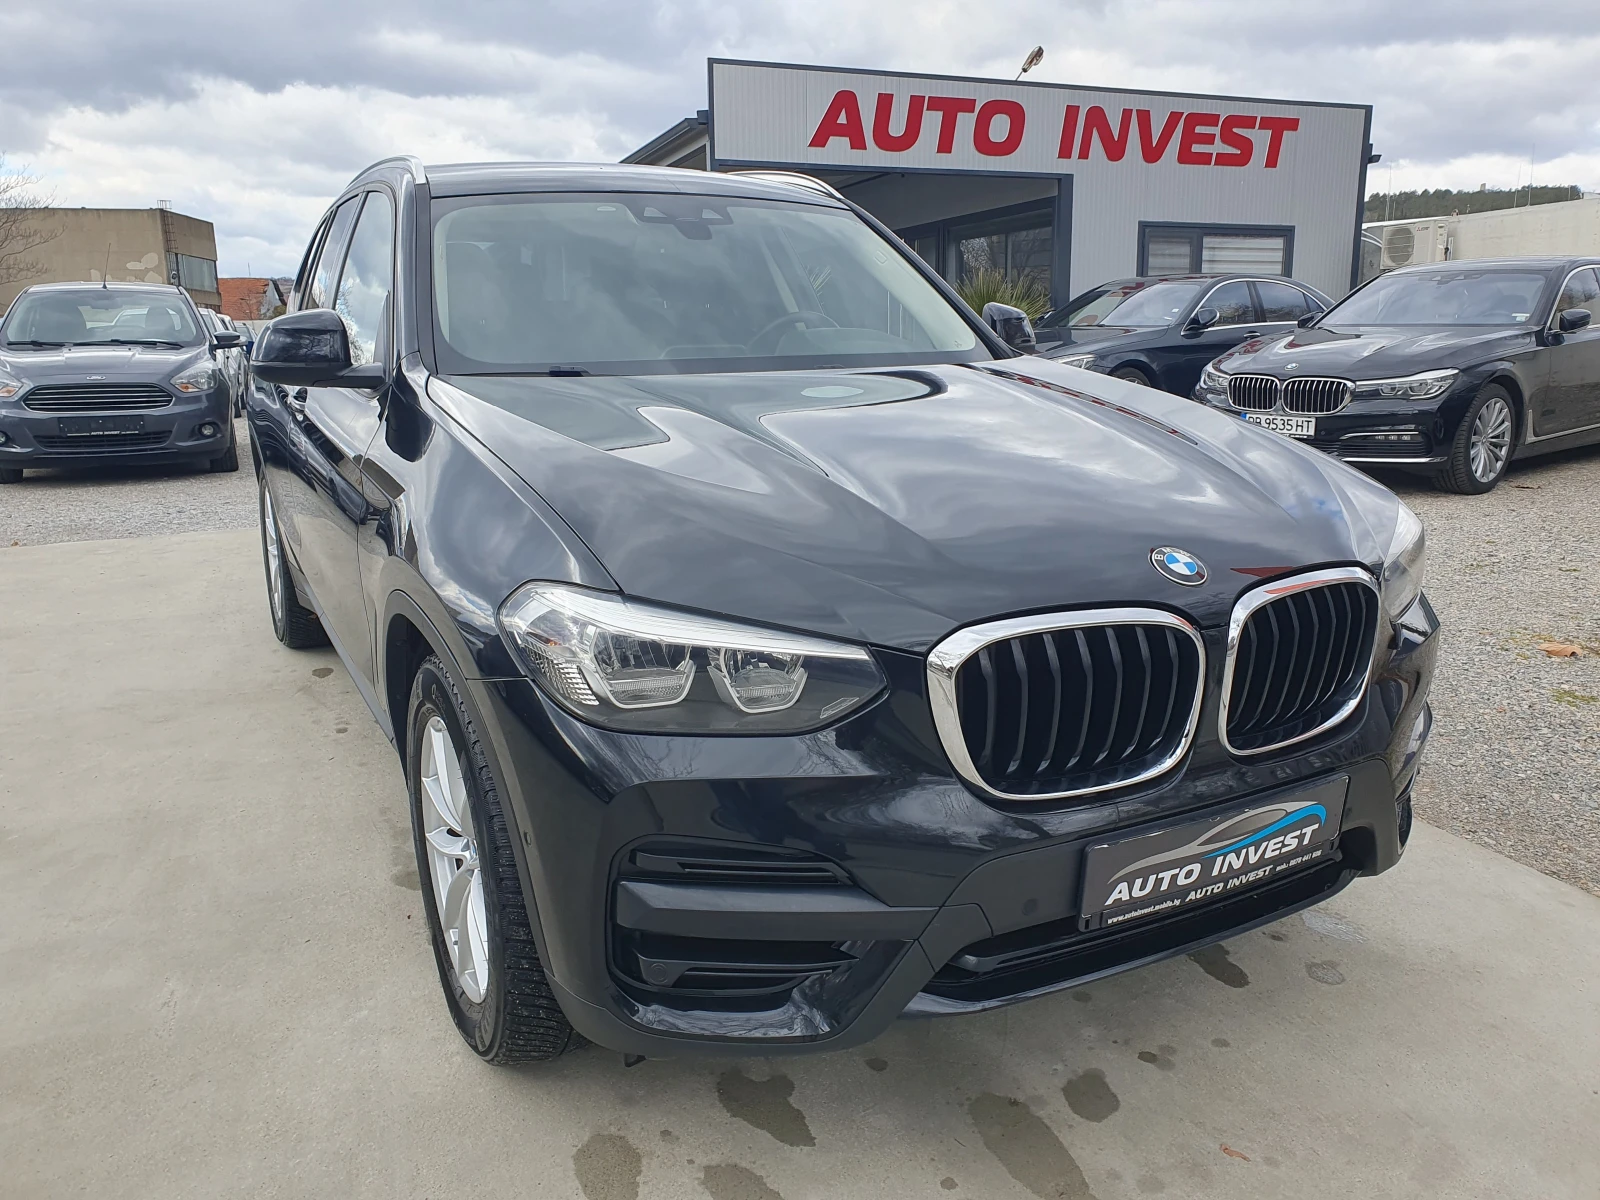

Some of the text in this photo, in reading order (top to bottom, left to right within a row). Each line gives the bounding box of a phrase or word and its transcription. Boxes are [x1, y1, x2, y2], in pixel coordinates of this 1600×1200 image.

[808, 90, 1301, 169] AUTO INVEST
[1264, 417, 1294, 432] 9535
[1295, 419, 1313, 433] HT
[1104, 823, 1320, 906] AUTO INVEST
[1185, 882, 1225, 903] AUTO
[1226, 864, 1274, 890] INVEST
